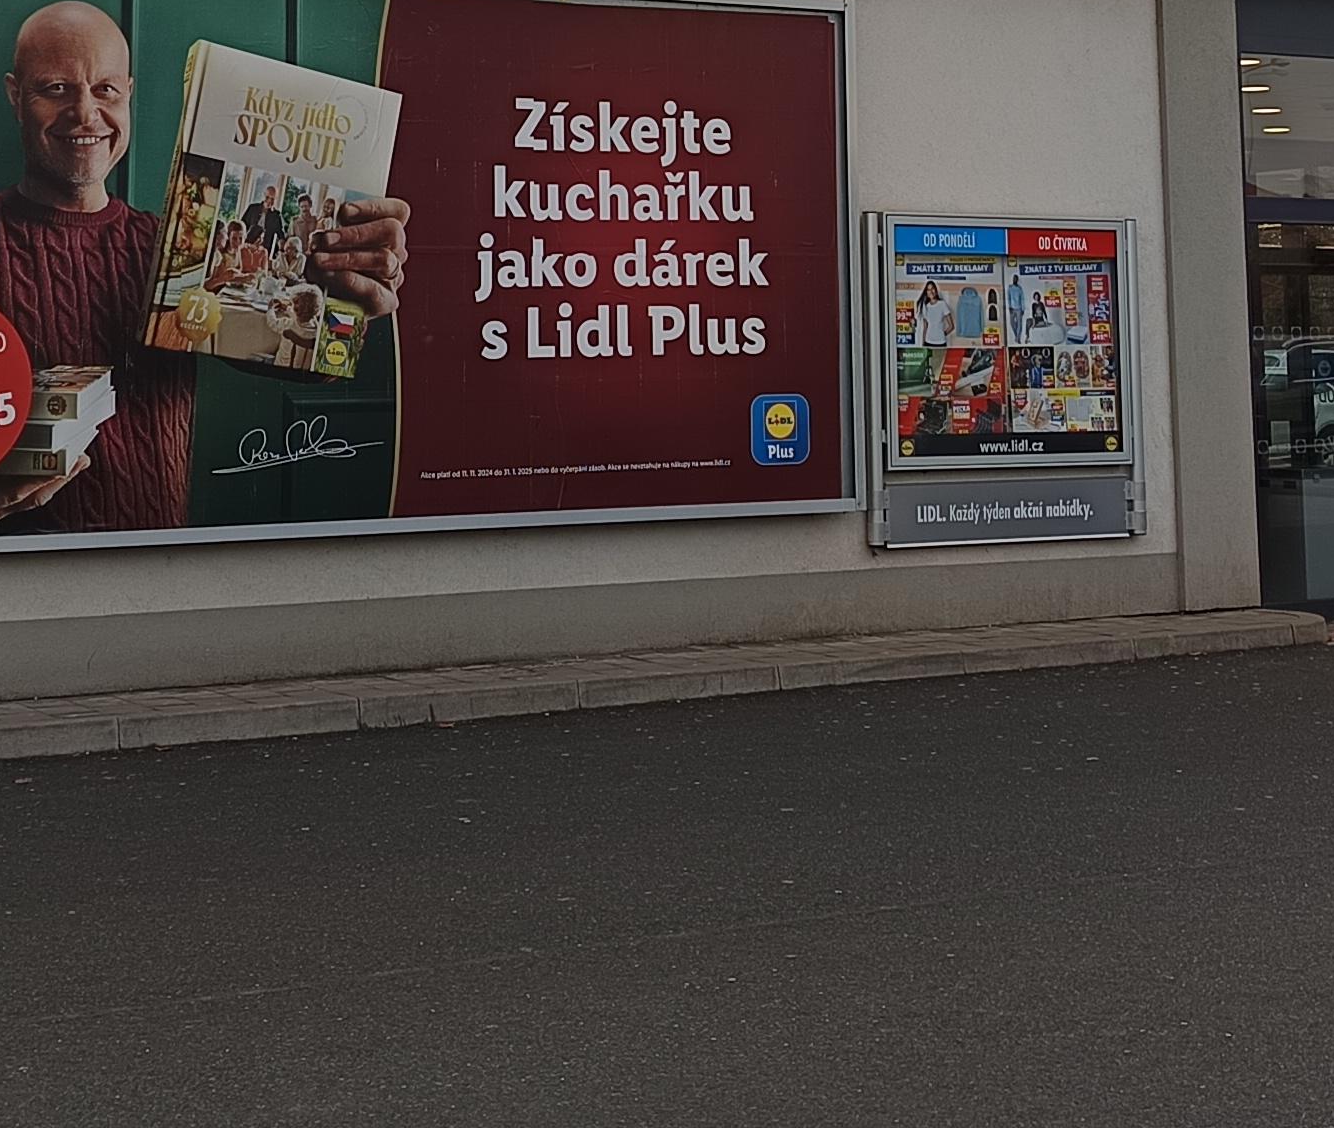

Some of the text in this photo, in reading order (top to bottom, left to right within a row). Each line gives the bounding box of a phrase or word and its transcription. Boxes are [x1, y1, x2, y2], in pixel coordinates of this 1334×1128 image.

[243, 85, 296, 122] Když
[297, 99, 351, 136] jídlo
[234, 114, 347, 170] SPOJUJE
[514, 97, 732, 167] Získejte
[494, 165, 754, 222] kuchařku
[923, 231, 976, 248] OD PONDĚLÍ
[1038, 233, 1087, 251] OD ČTVRTKA
[475, 233, 769, 303] jako dárek
[1053, 264, 1063, 272] TV
[186, 295, 209, 323] 73
[481, 303, 766, 360] s Lidl Plus
[767, 444, 794, 459] Plus
[979, 439, 1044, 453] www.lidl.cz
[452, 470, 460, 478] od
[917, 499, 1094, 525] LIDL. Každý týden akční nabídky.
